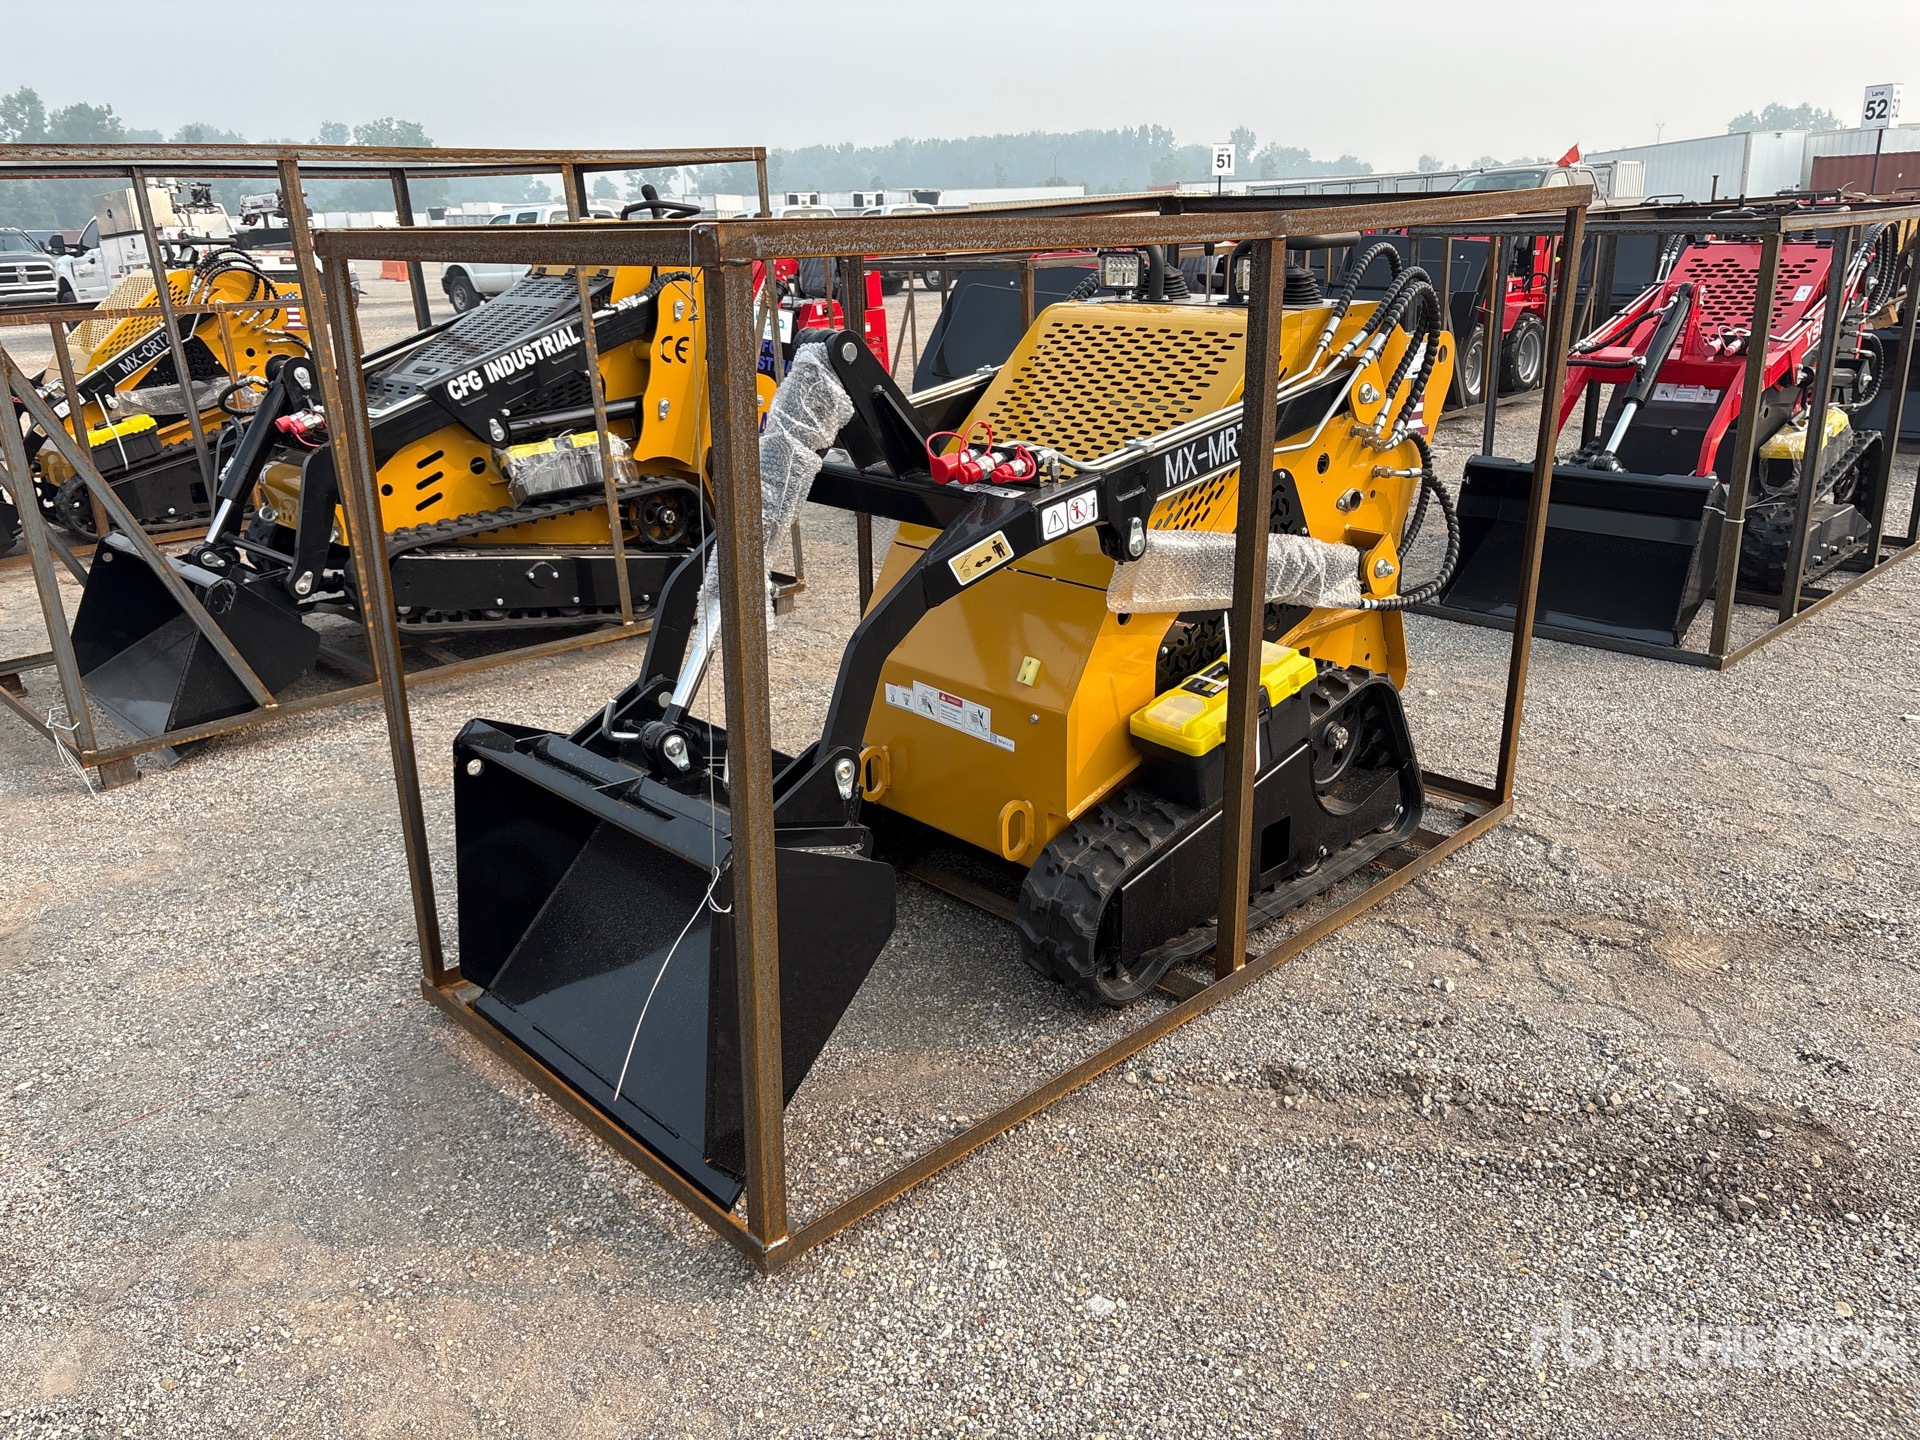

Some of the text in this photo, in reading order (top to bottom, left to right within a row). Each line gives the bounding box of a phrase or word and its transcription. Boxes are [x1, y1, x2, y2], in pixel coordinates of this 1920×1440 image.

[1864, 99, 1888, 120] 52
[1216, 154, 1231, 168] 51
[447, 325, 581, 400] CFG INDUSTRIAL
